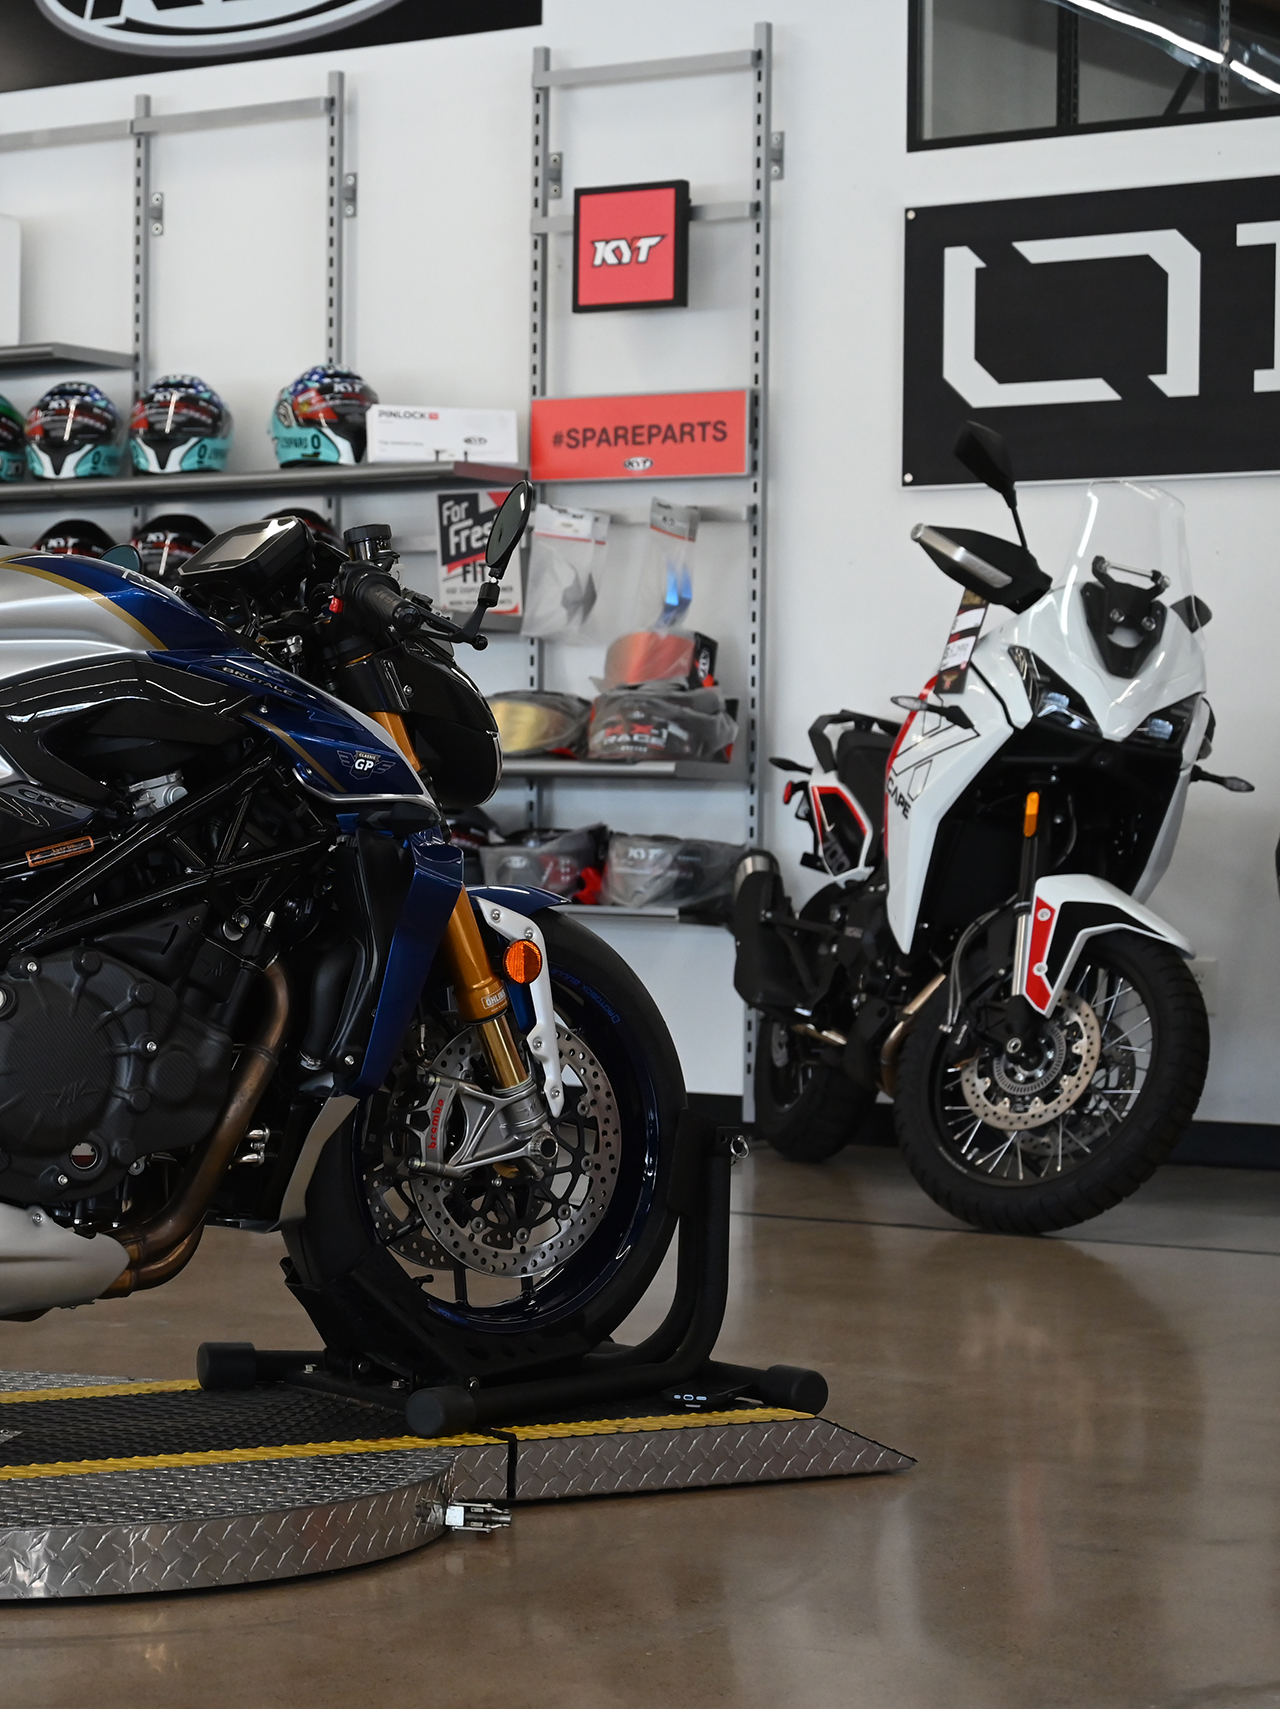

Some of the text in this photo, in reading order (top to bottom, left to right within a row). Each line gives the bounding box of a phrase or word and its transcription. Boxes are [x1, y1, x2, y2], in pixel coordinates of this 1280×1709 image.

[591, 234, 667, 267] KYT
[552, 420, 728, 450] #SPAREPARTS
[441, 499, 469, 527] For
[462, 560, 487, 583] FIT
[222, 666, 294, 696] BRUTALE
[354, 758, 375, 772] GP
[17, 788, 78, 814] CRC
[428, 1098, 445, 1150] brembo
